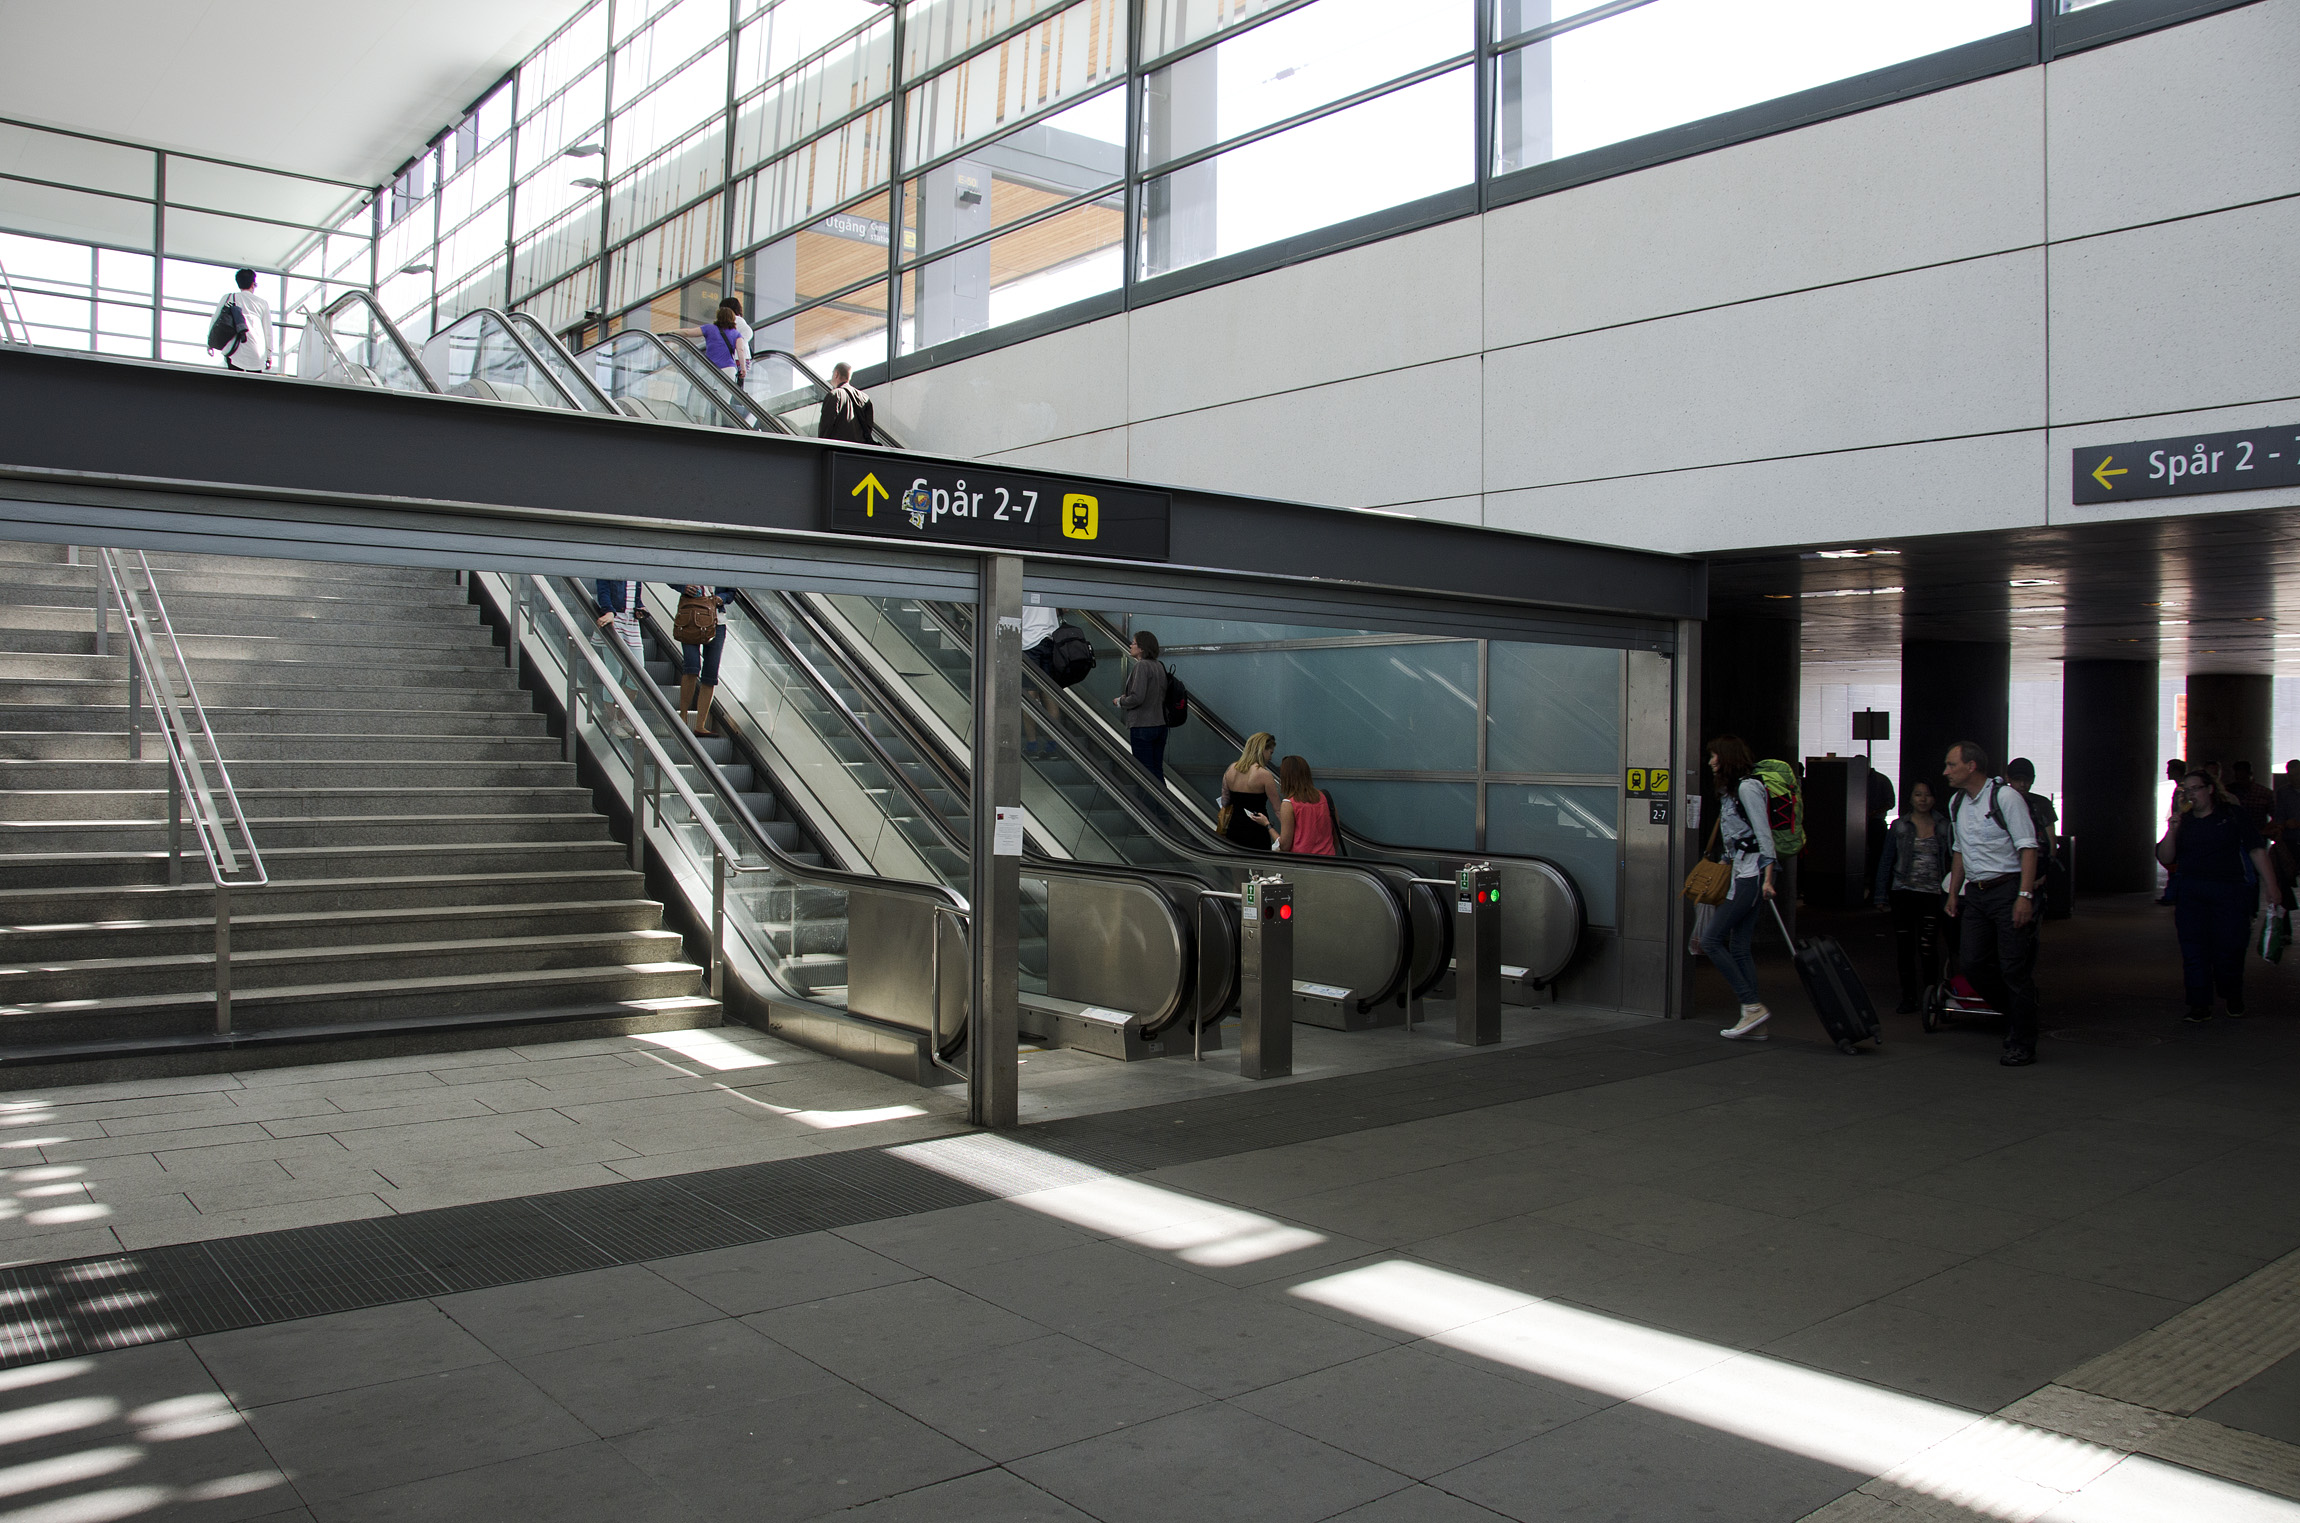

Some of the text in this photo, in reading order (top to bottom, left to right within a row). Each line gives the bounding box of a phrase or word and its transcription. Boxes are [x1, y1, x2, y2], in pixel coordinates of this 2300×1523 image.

[825, 216, 866, 237] Utgång
[2149, 443, 2223, 485] Spår
[2235, 441, 2254, 471] 2
[994, 488, 1038, 522] 2-7
[1653, 810, 1666, 819] 2-7
